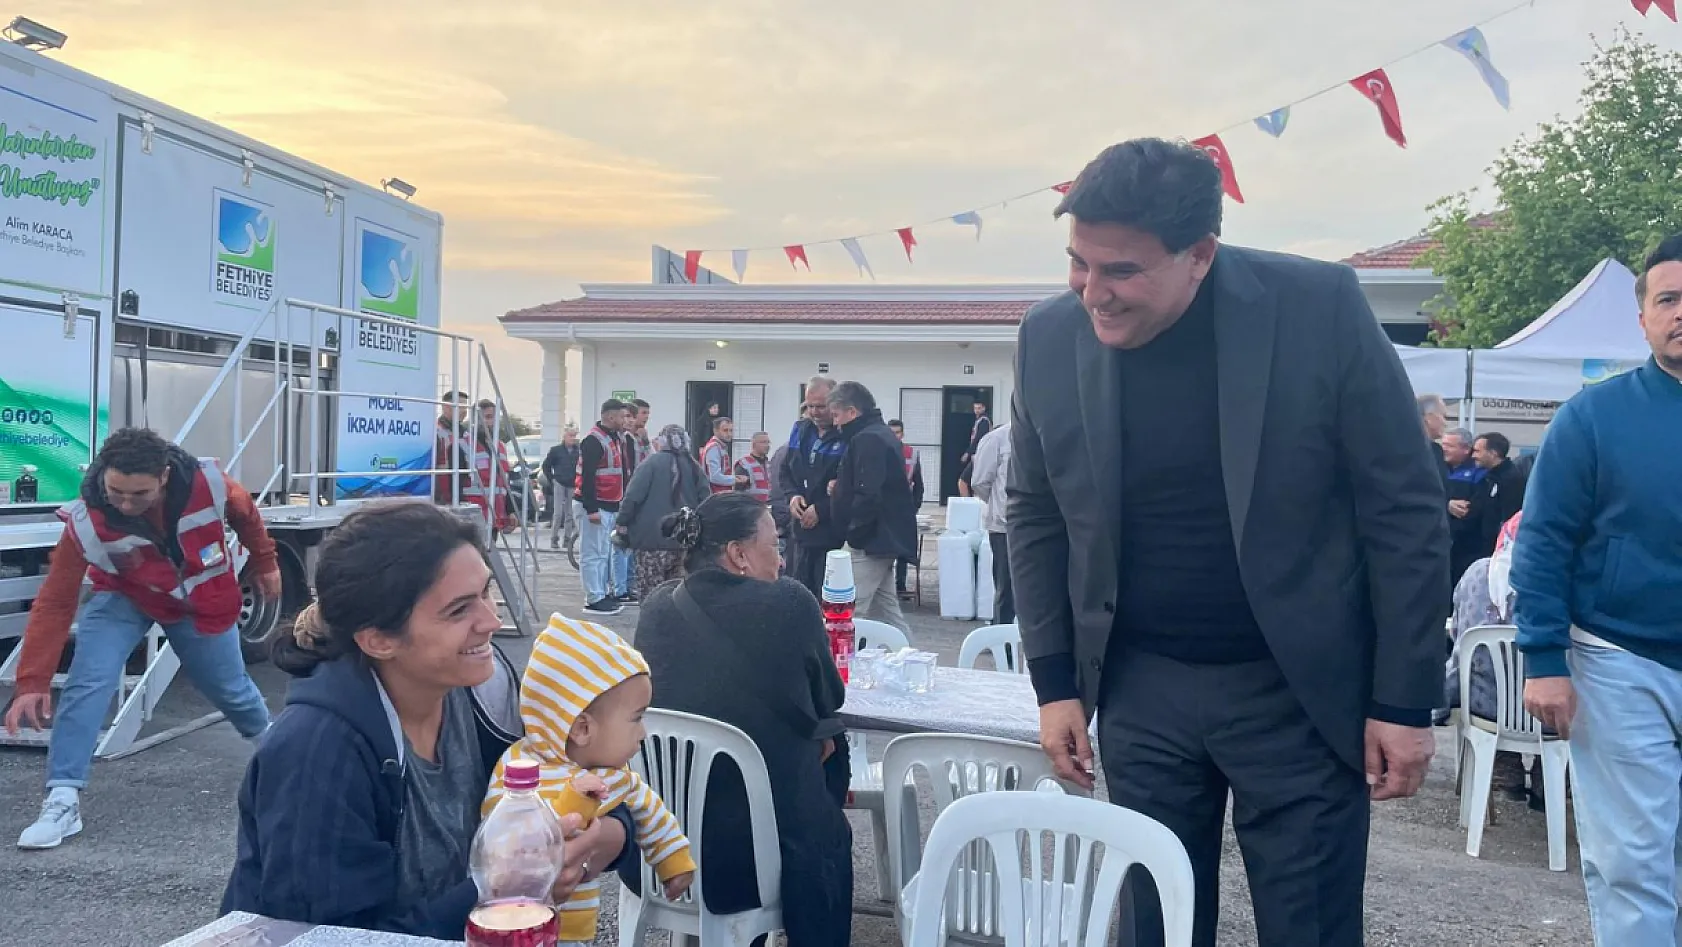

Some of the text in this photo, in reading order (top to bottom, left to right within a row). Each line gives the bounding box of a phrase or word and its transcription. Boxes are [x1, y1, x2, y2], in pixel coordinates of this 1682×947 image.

[6, 215, 73, 242] Alim KARACA
[22, 234, 54, 252] Belediye
[368, 392, 404, 411] MOBİL
[347, 412, 421, 436] İKRAM ARACI
